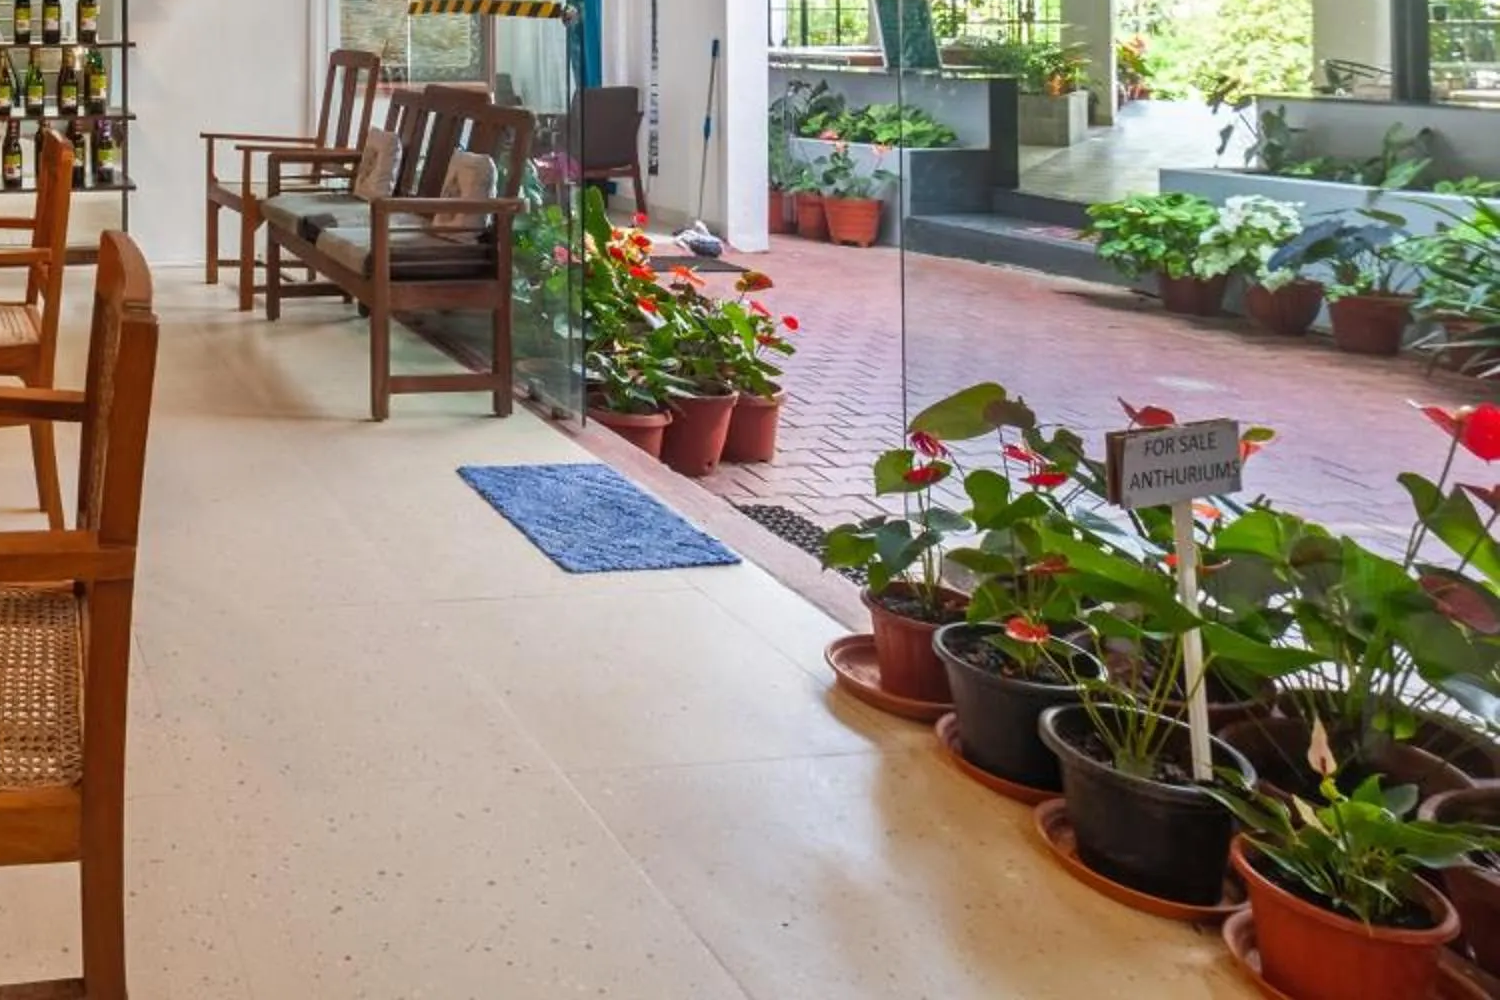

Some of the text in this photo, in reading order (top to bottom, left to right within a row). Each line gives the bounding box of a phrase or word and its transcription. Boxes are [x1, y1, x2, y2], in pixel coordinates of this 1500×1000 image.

[1143, 431, 1218, 456] FOR SALE
[1129, 460, 1241, 489] ANTHURIUMS
